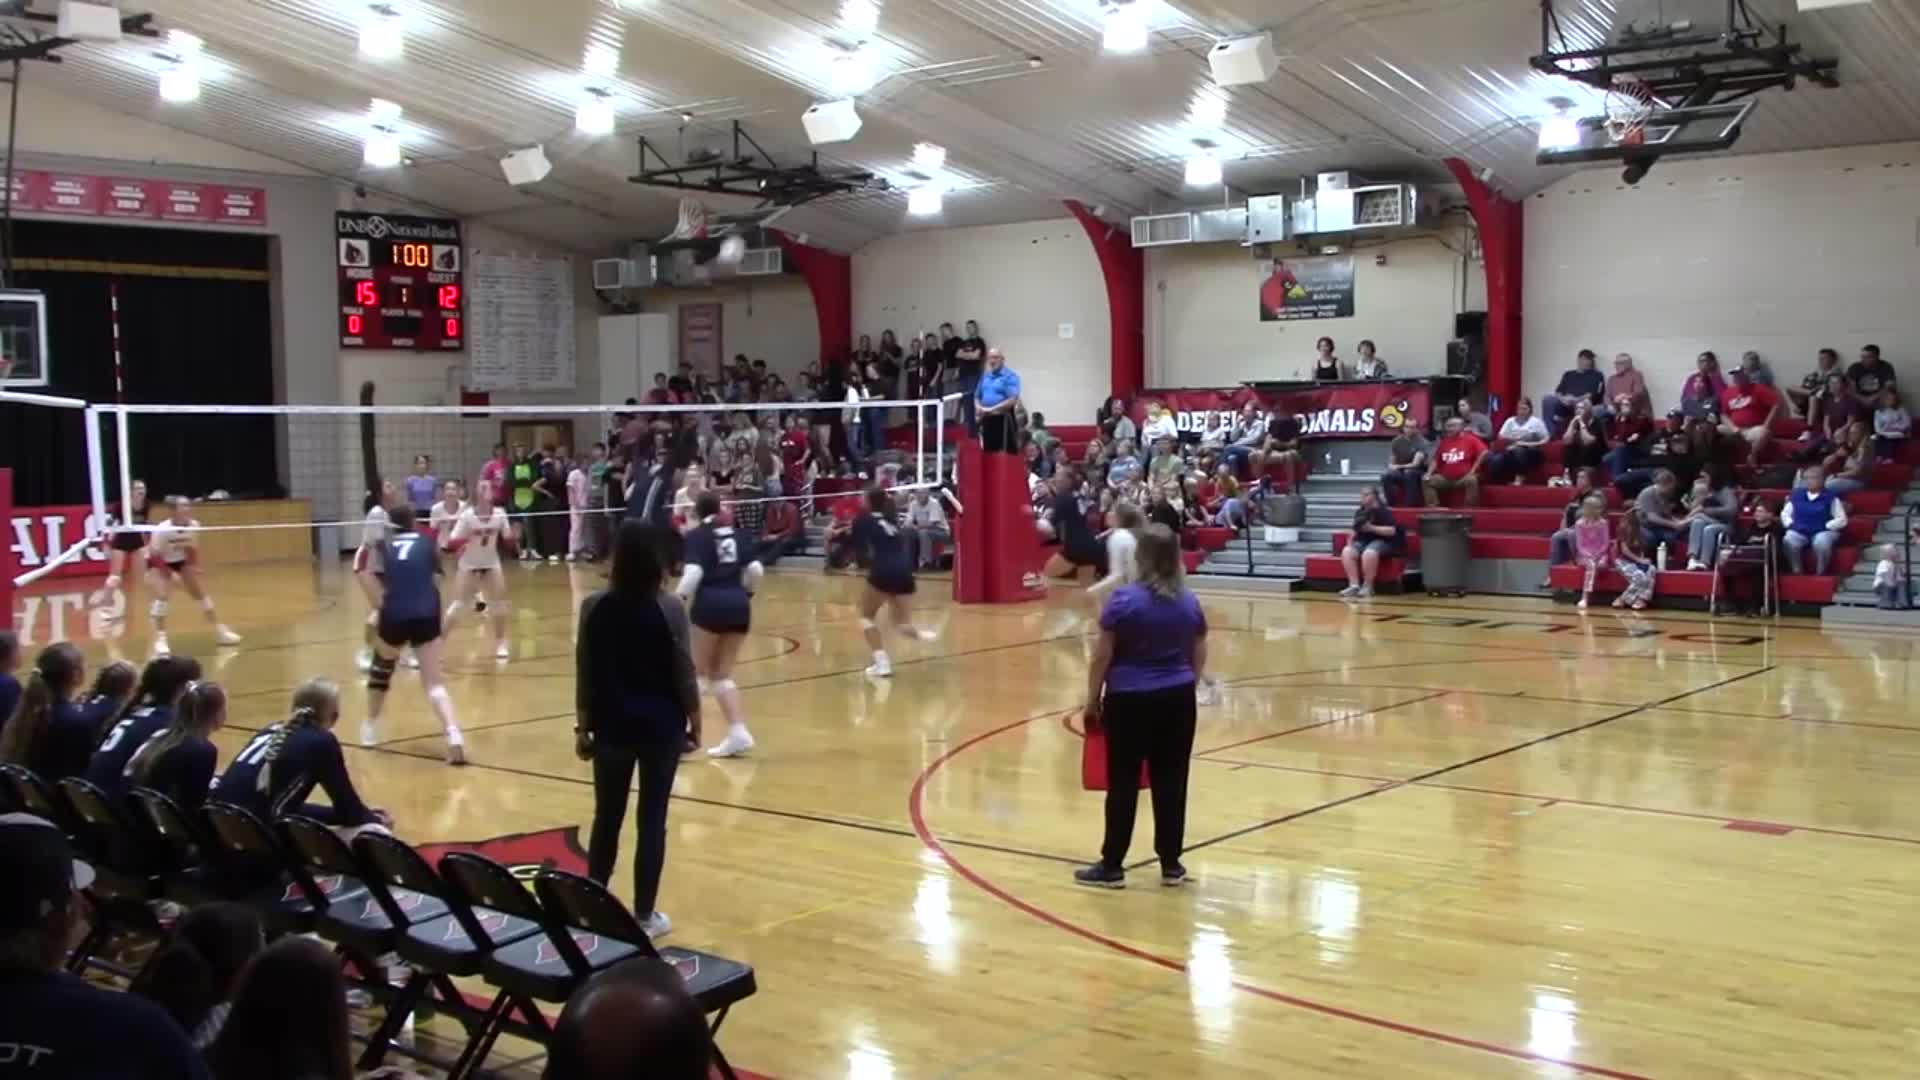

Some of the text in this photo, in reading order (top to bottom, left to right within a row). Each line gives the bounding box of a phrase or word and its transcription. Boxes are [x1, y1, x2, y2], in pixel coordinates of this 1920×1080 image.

[338, 218, 457, 239] DNB National Bank
[357, 282, 376, 305] 15
[402, 288, 407, 303] 1
[439, 286, 458, 308] 12
[348, 315, 360, 334] 0
[446, 318, 457, 337] 0
[392, 540, 415, 561] 7
